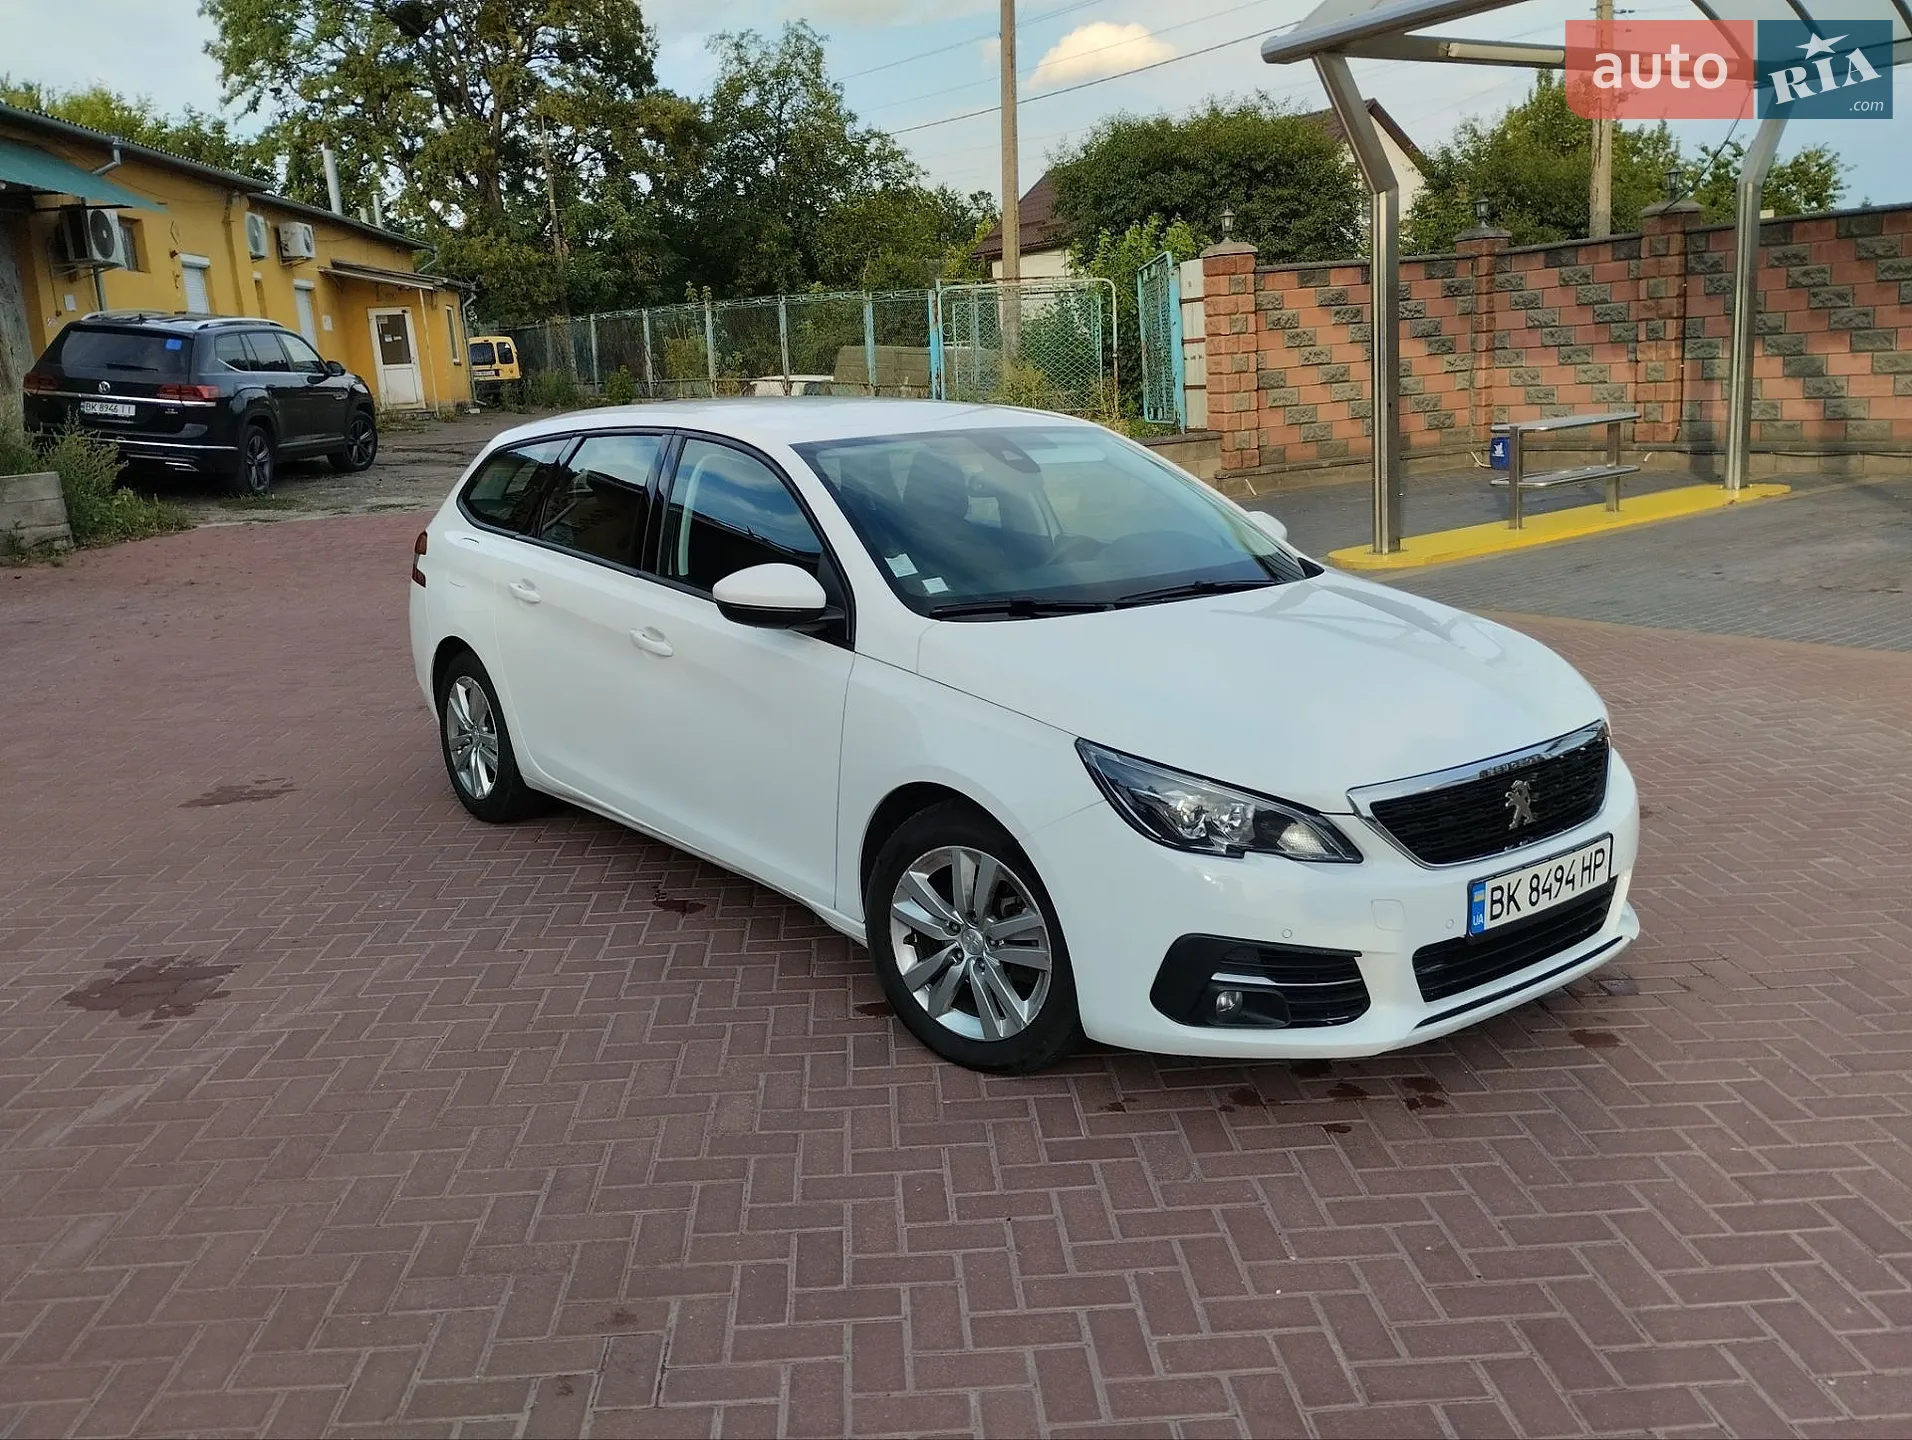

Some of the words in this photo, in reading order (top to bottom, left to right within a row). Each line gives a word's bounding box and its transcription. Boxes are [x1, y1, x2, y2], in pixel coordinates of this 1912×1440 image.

[85, 402, 97, 412] BK
[1489, 878, 1522, 921] BK
[1528, 859, 1576, 907] 8494
[1580, 847, 1605, 888] HP
[1472, 914, 1484, 926] UA
